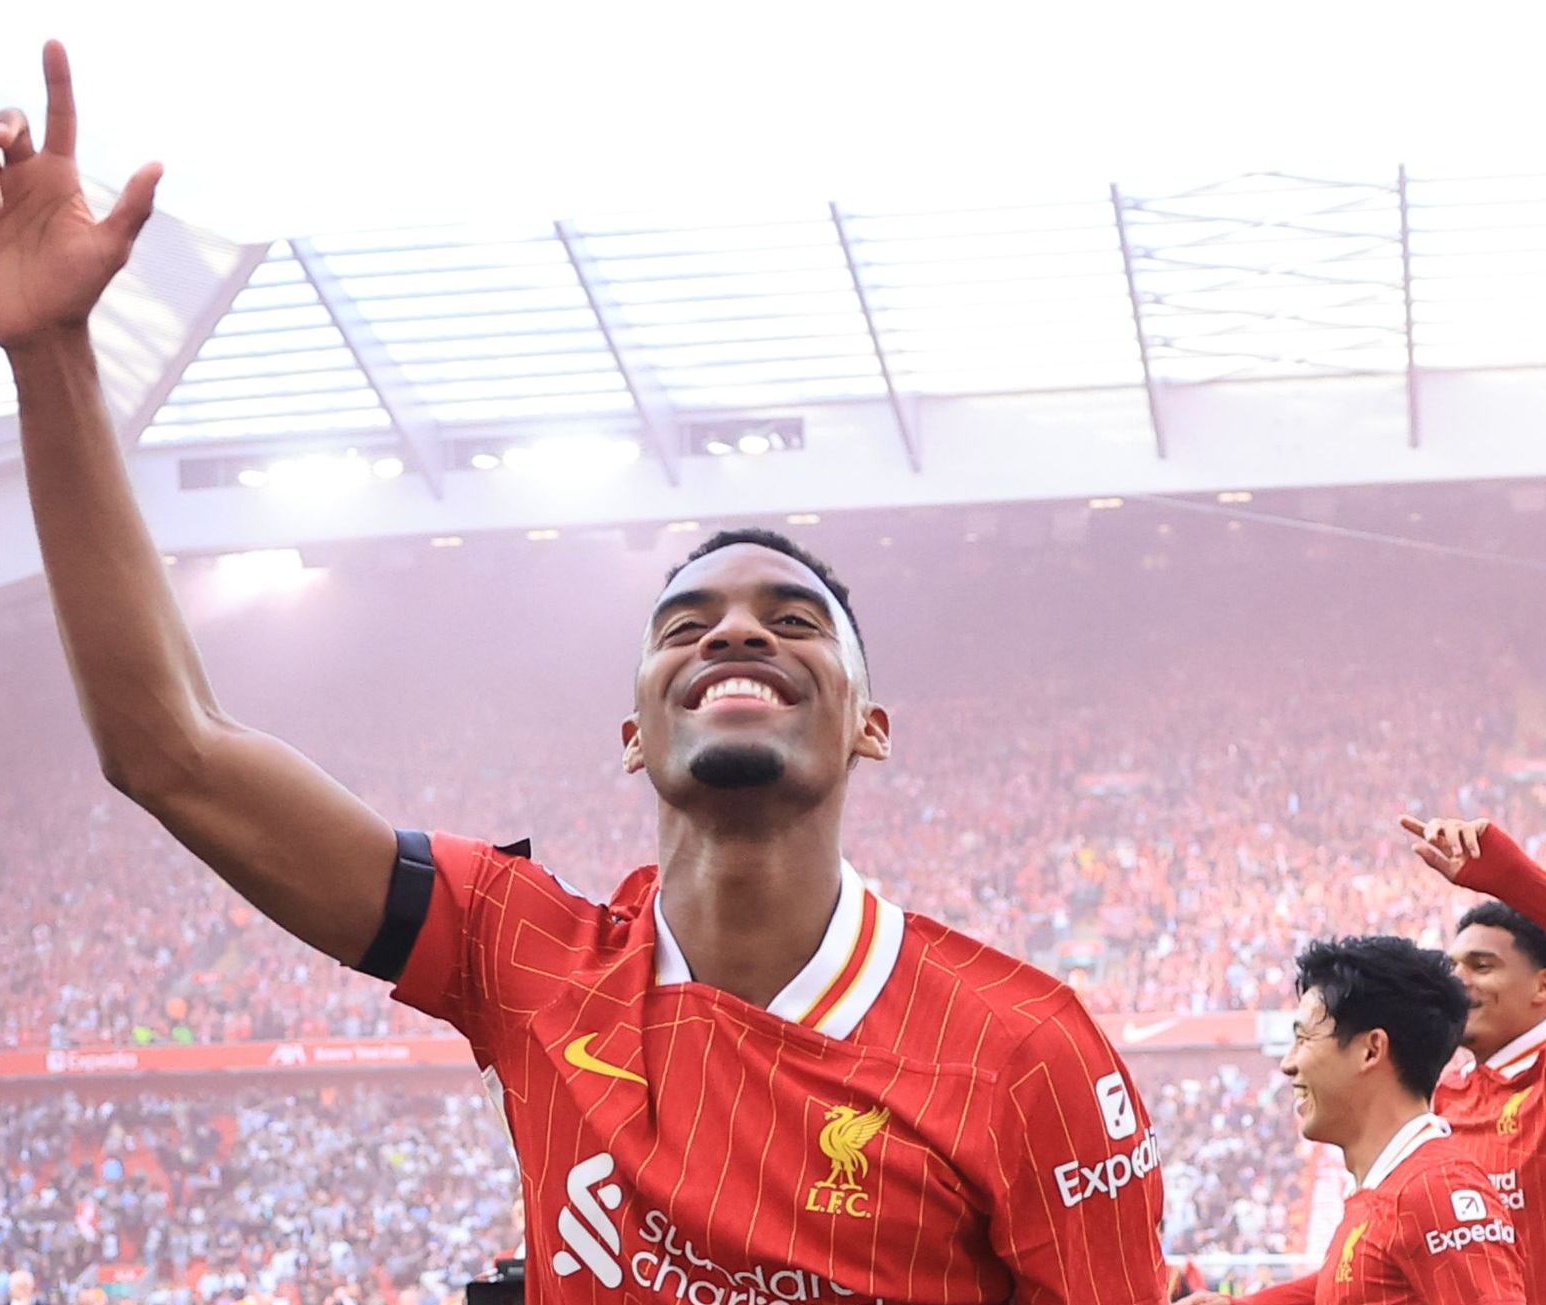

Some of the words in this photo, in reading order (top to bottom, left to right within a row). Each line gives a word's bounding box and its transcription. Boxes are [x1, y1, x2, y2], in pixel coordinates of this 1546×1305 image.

[1054, 1125, 1162, 1208] Expedi
[805, 1188, 872, 1218] L.F.C.
[1425, 1219, 1516, 1255] Expedia
